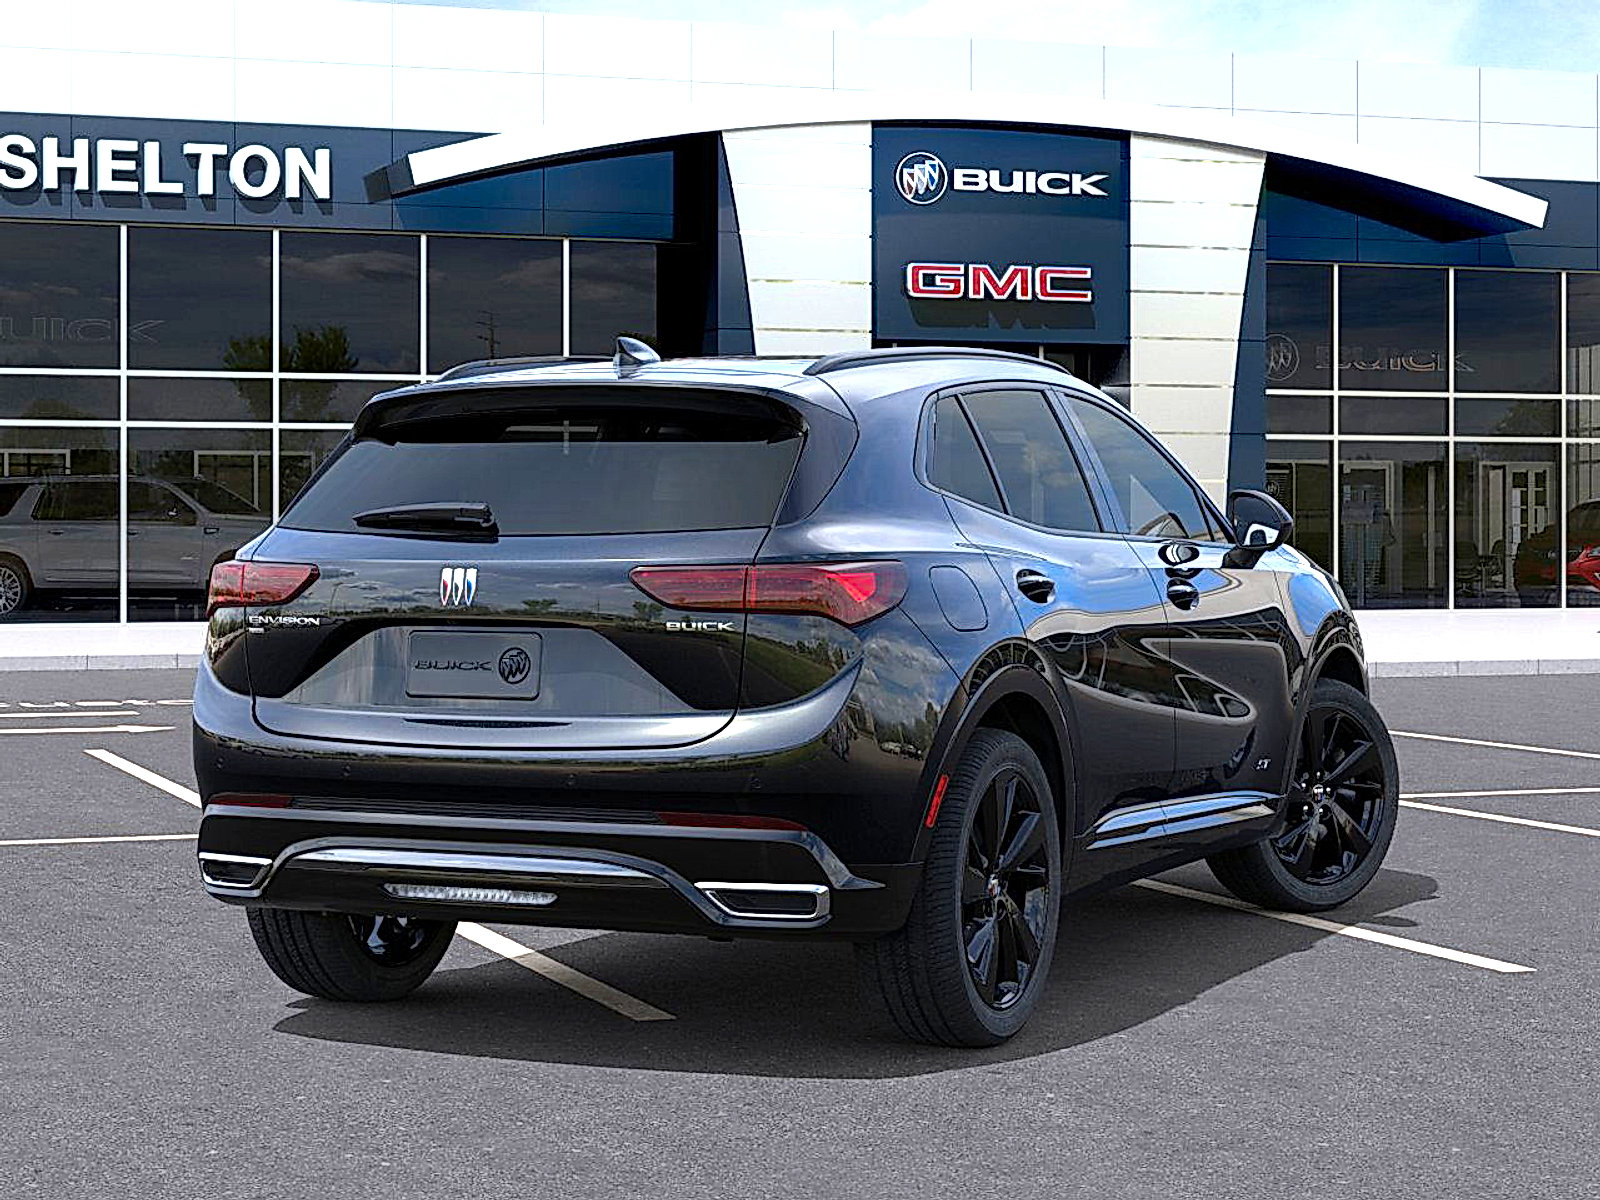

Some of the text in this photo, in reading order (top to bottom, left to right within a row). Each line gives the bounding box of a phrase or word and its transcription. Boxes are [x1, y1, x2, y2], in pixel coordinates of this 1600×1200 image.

[0, 134, 331, 200] SHELTON
[953, 168, 1109, 197] BUICK
[907, 262, 1092, 302] GMC
[248, 615, 320, 626] ENVISION
[665, 621, 736, 632] BUICK
[414, 659, 494, 671] BUICK
